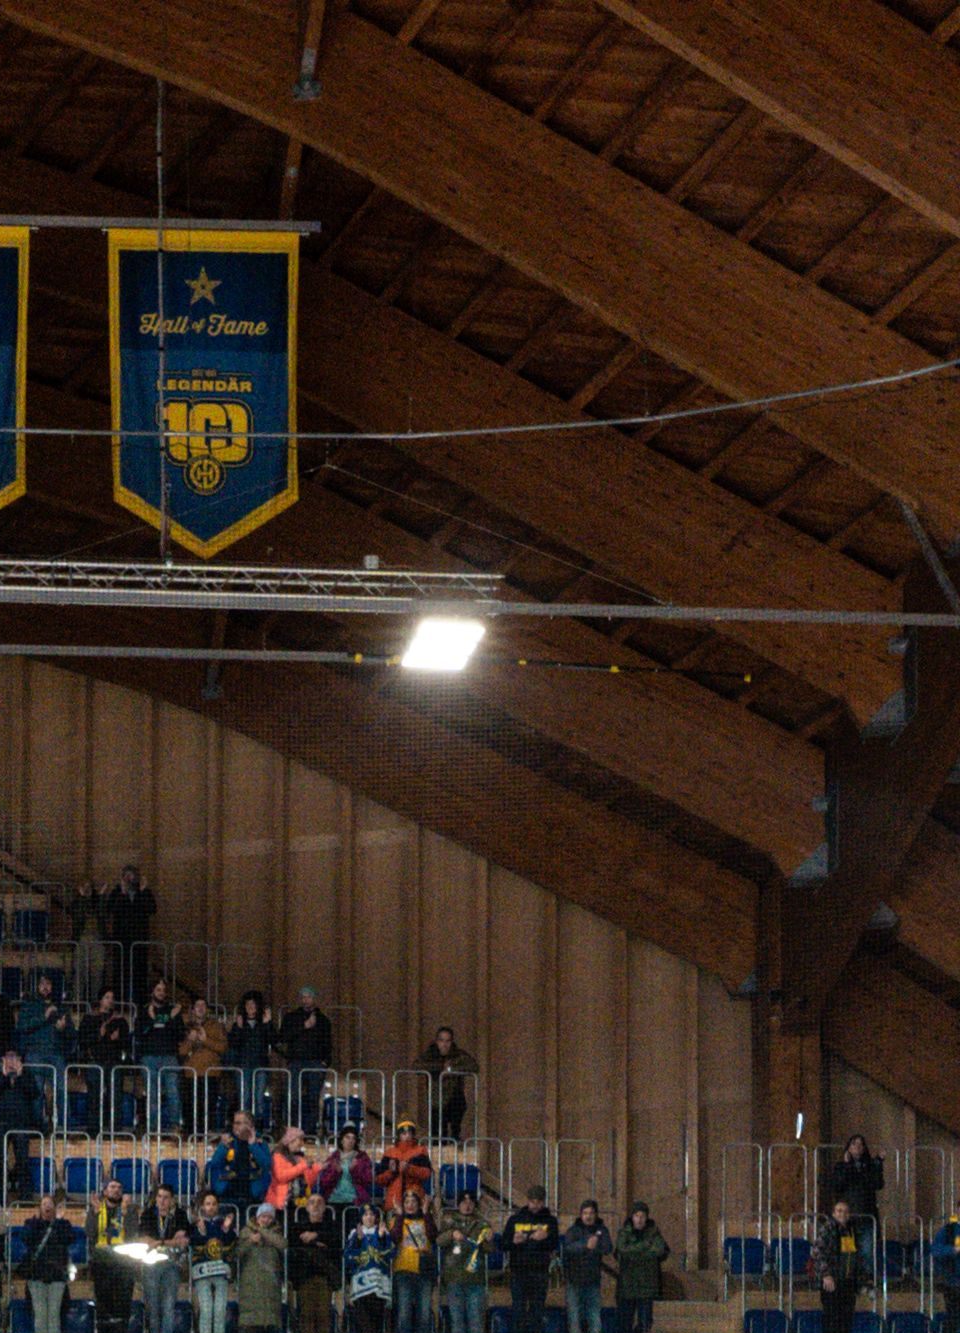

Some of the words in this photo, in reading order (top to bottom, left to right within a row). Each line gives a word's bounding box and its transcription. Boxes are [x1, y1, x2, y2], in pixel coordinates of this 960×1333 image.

[140, 313, 189, 336] Hall
[207, 314, 269, 337] Fame
[157, 377, 252, 392] LEGENDÄR
